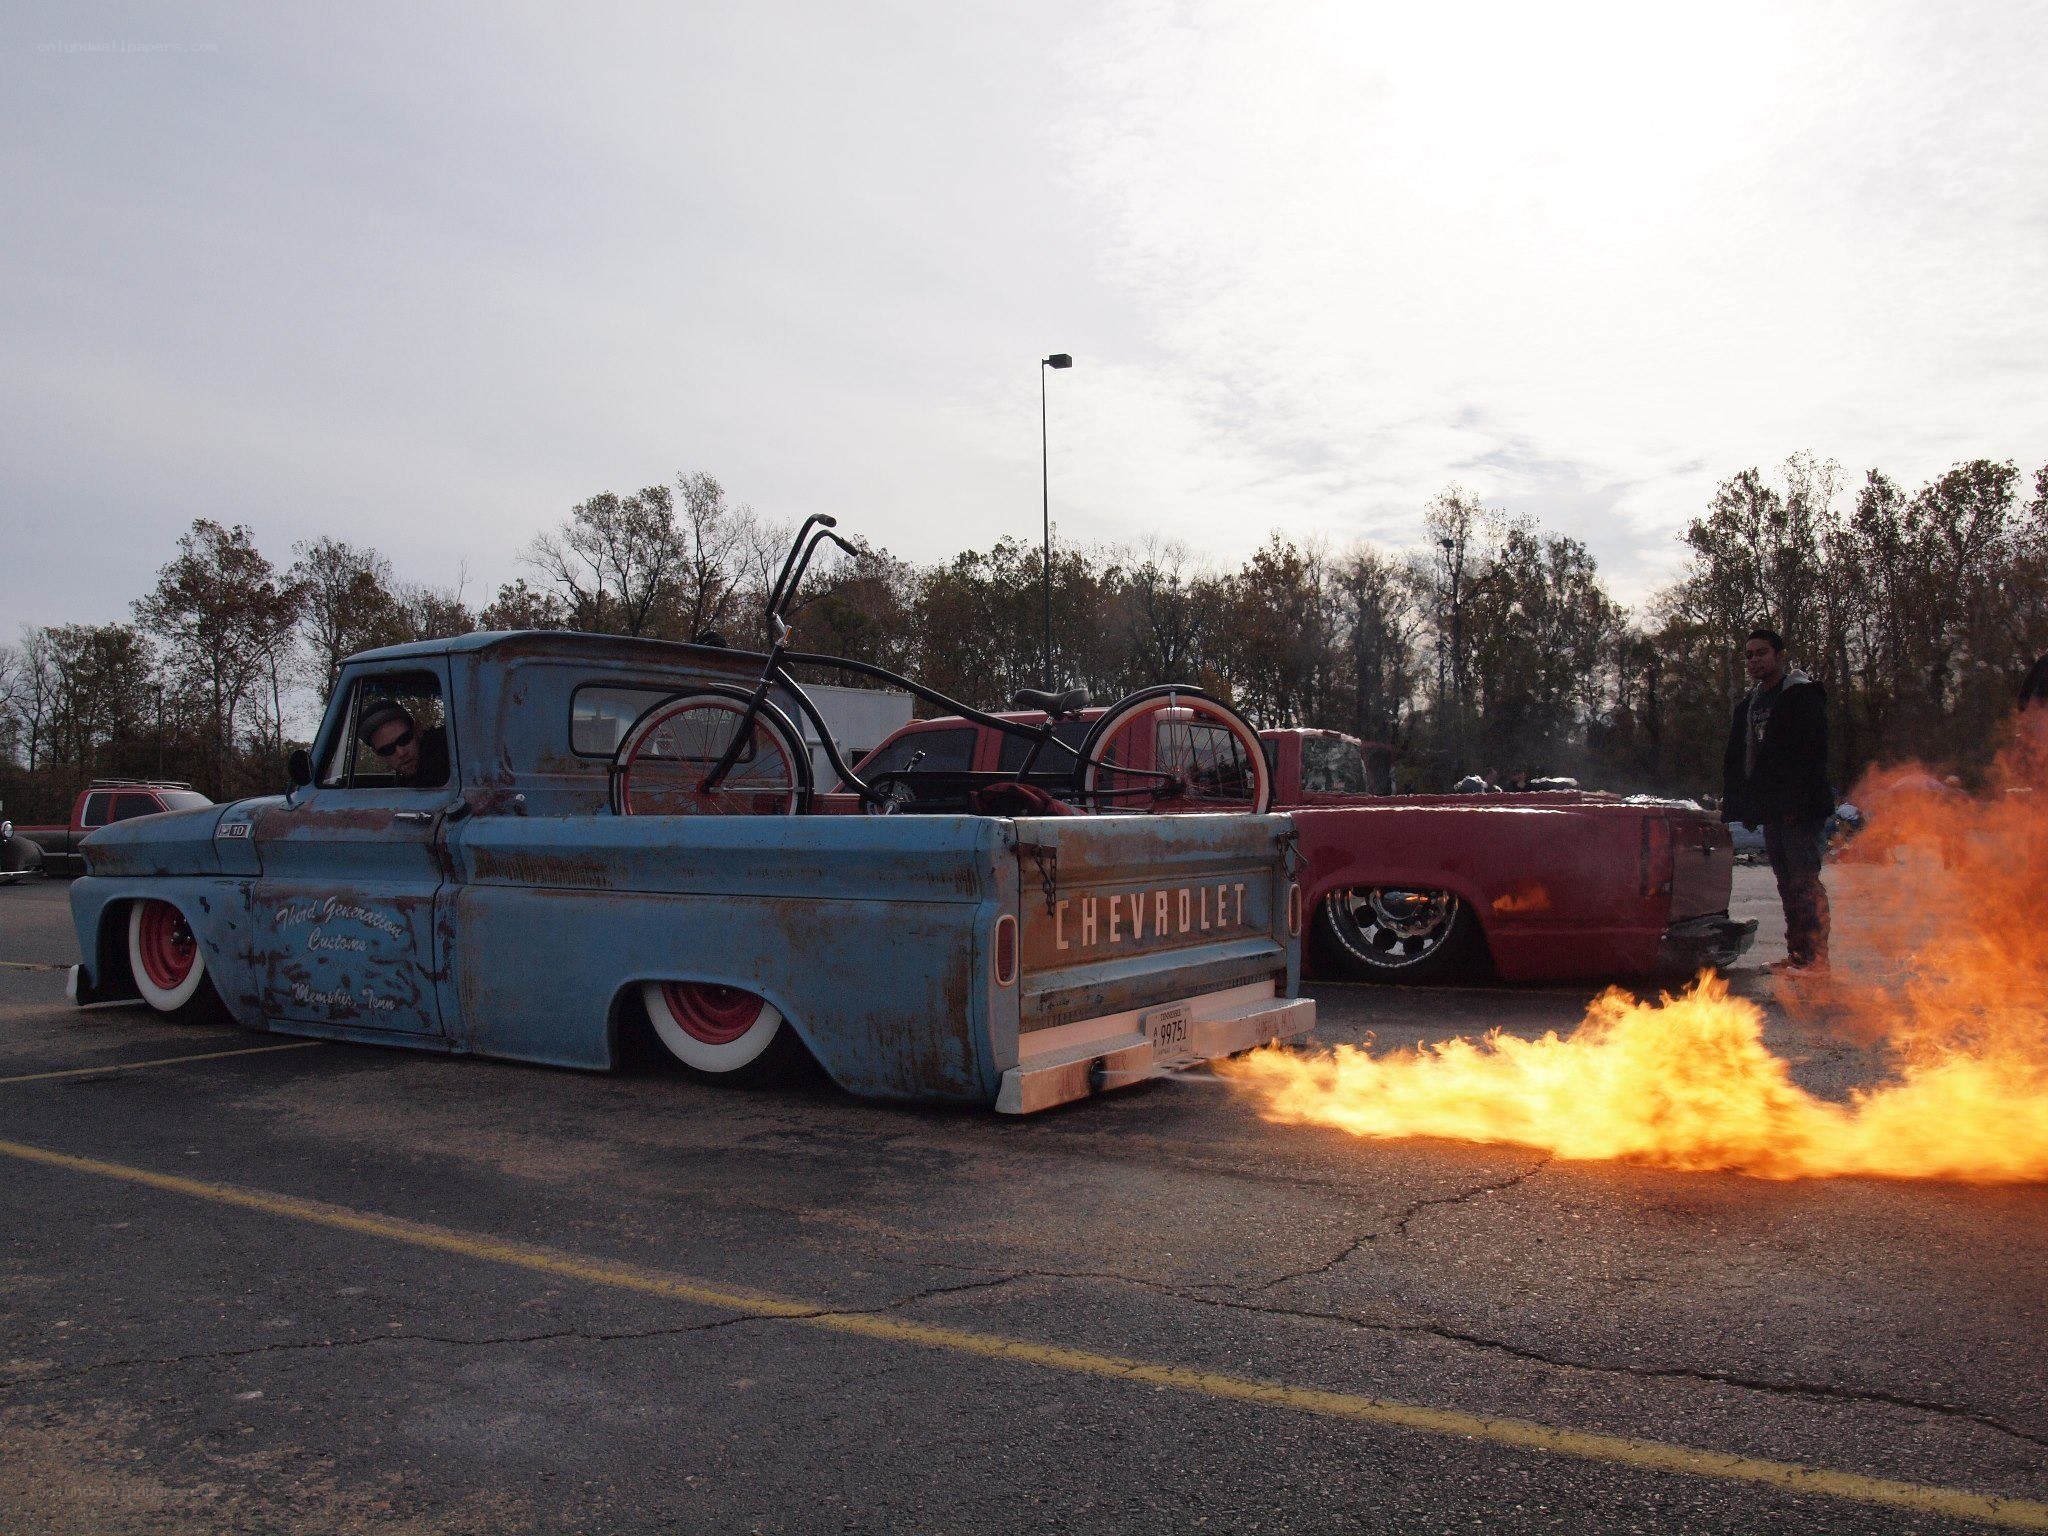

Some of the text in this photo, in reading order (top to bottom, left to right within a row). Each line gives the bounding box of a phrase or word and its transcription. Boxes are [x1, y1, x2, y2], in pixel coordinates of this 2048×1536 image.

[276, 895, 403, 938] Third Generation
[1056, 883, 1245, 950] CHEVROLET
[1160, 1018, 1187, 1046] 99751
